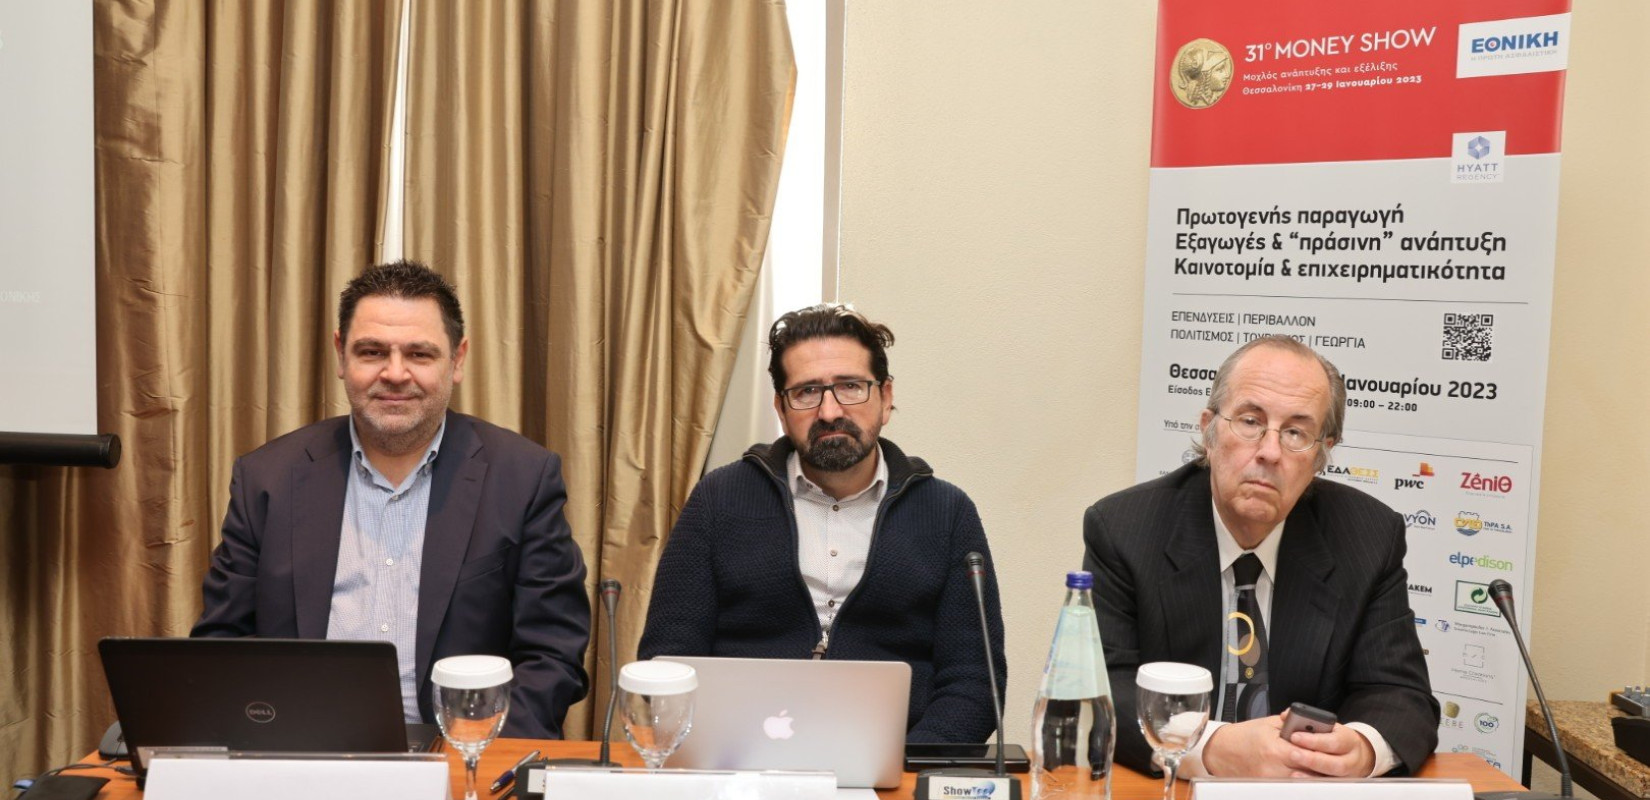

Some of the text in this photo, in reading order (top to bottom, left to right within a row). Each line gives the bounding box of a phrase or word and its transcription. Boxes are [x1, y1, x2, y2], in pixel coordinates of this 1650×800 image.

[1274, 34, 1354, 60] MONEY
[1360, 26, 1437, 52] SHOW
[1243, 61, 1398, 82] Μοχλός ανάπτυξης και εξέλιξης
[1242, 82, 1302, 95] Θεσσαλονίκη
[1336, 76, 1393, 89] Ιανουαρίου
[1396, 75, 1422, 84] 2023
[1457, 163, 1498, 172] HYATT
[1176, 203, 1404, 229] Πρωτογενής παραγωγή
[1175, 231, 1266, 254] Εξαγωγές
[1272, 233, 1283, 250] &
[1400, 231, 1507, 256] ανάπτυξη
[1174, 257, 1506, 283] Καινοτομία & επιχειρηματικότητα
[1171, 310, 1235, 324] ΕΠΕΝΔΥΣΕΙΣ
[1243, 313, 1316, 327] ΠΕΡΙΒΑΛΛΟΝ
[1170, 328, 1234, 342] ΠΟΛΙΤΙΣΜΟΣ
[1315, 336, 1366, 349] ΓΕΩΡΓΙΑ
[1169, 363, 1217, 381] Θεσσα
[1447, 381, 1498, 400] 2023
[1167, 384, 1203, 396] Είσοδος
[1347, 398, 1375, 409] 09:00
[1387, 401, 1418, 412] 22:00
[1163, 419, 1179, 429] Υπό
[1180, 422, 1193, 430] την
[1394, 478, 1424, 490] pwc
[1480, 720, 1494, 728] 100
